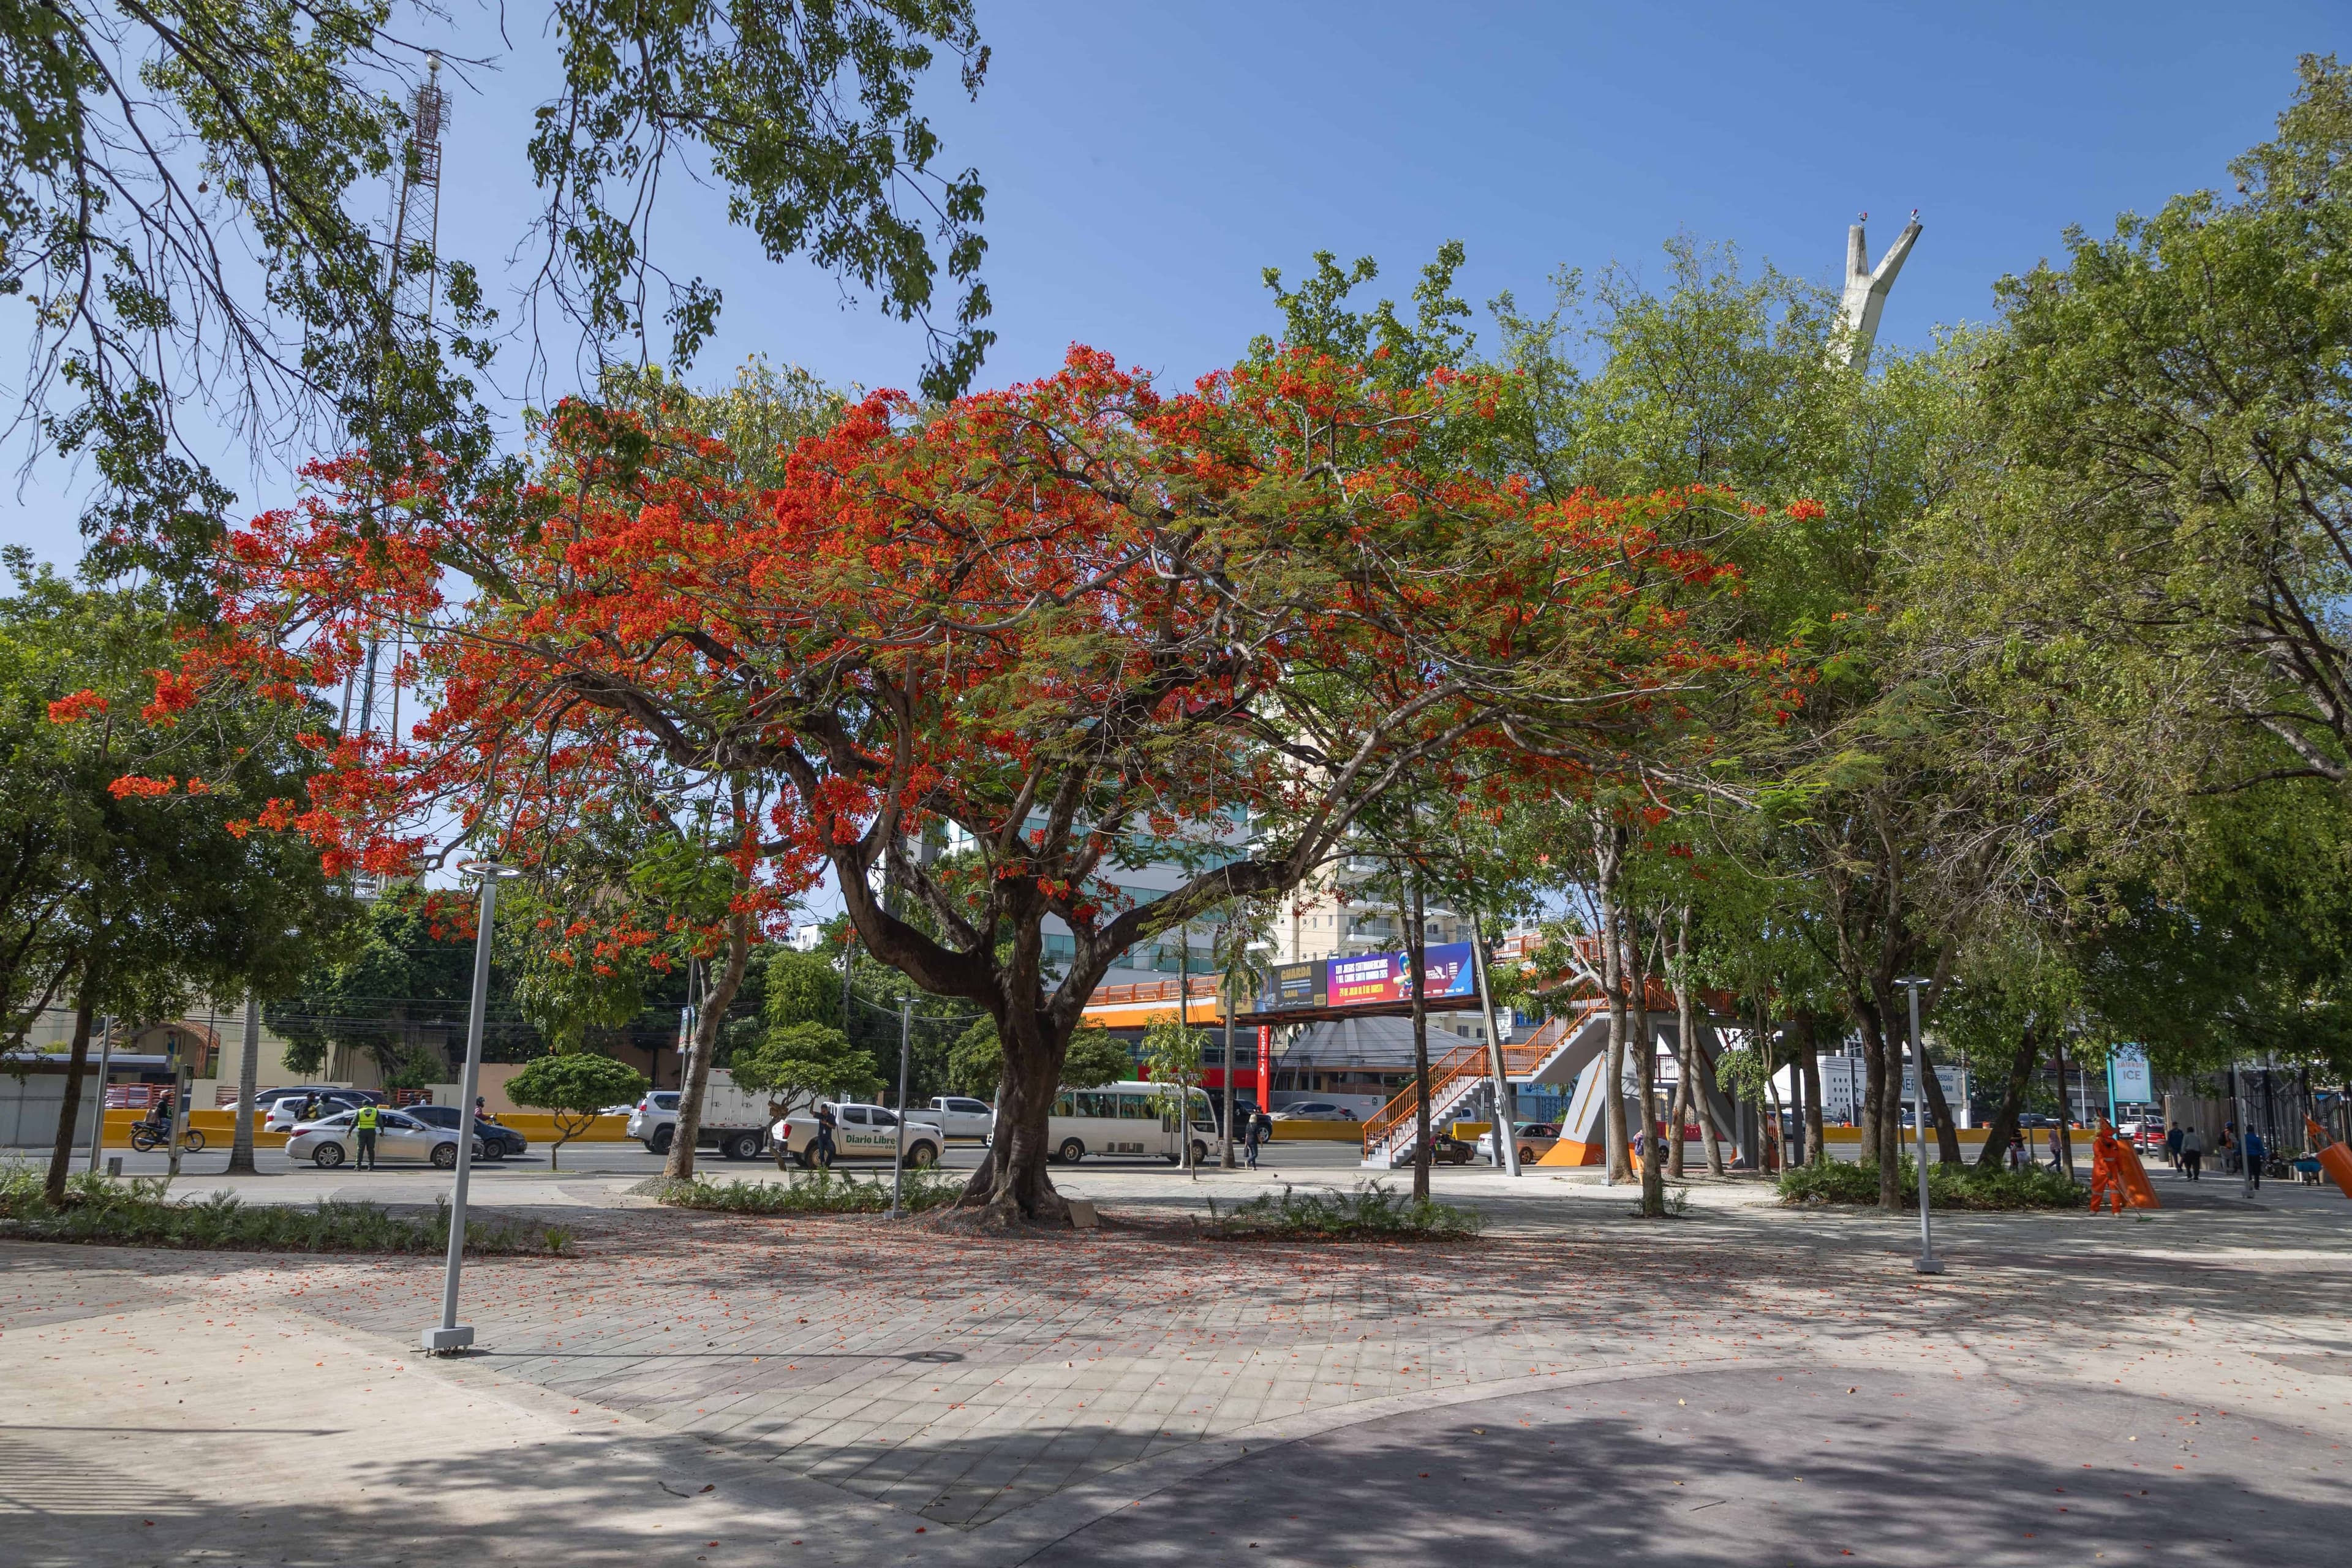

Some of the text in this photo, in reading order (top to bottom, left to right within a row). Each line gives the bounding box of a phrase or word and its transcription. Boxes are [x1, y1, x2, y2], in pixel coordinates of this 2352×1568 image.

[1280, 965, 1312, 981] GUARDA
[2123, 1070, 2142, 1080] ICE
[846, 1134, 895, 1145] Diario Libre
